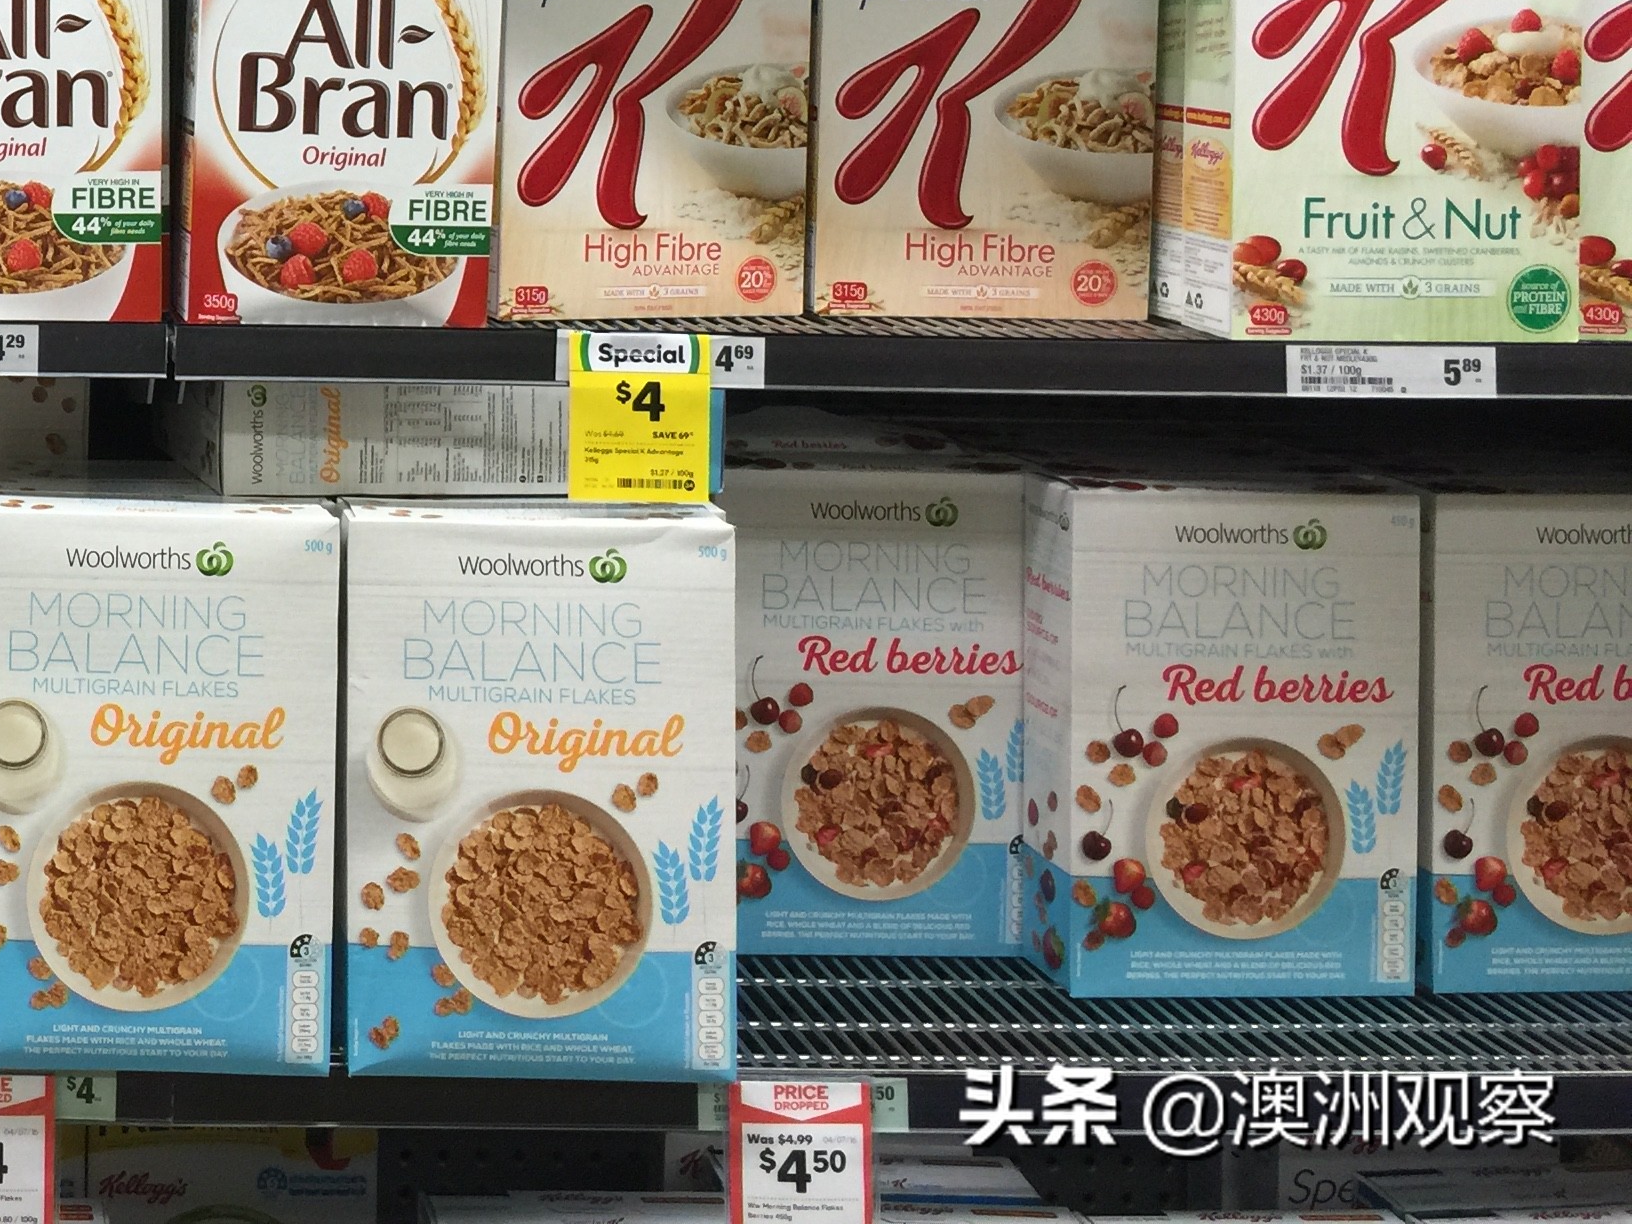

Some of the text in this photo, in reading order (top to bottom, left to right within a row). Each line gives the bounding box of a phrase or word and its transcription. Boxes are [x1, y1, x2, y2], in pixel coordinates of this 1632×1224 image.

[71, 186, 156, 210] FIBRE
[1301, 196, 1522, 241] Fruit & Nut
[583, 234, 722, 266] High Fibre
[1252, 307, 1286, 324] 430g
[598, 342, 686, 367] Special
[250, 404, 266, 486] Woolworths
[320, 387, 340, 485] Original
[304, 539, 332, 555] 500g
[29, 592, 247, 632] MORNING
[7, 630, 265, 679] BALANCE
[32, 678, 239, 698] MULTIGRAIN FLAKES
[1162, 664, 1394, 707] Red berries
[89, 703, 285, 765] Original
